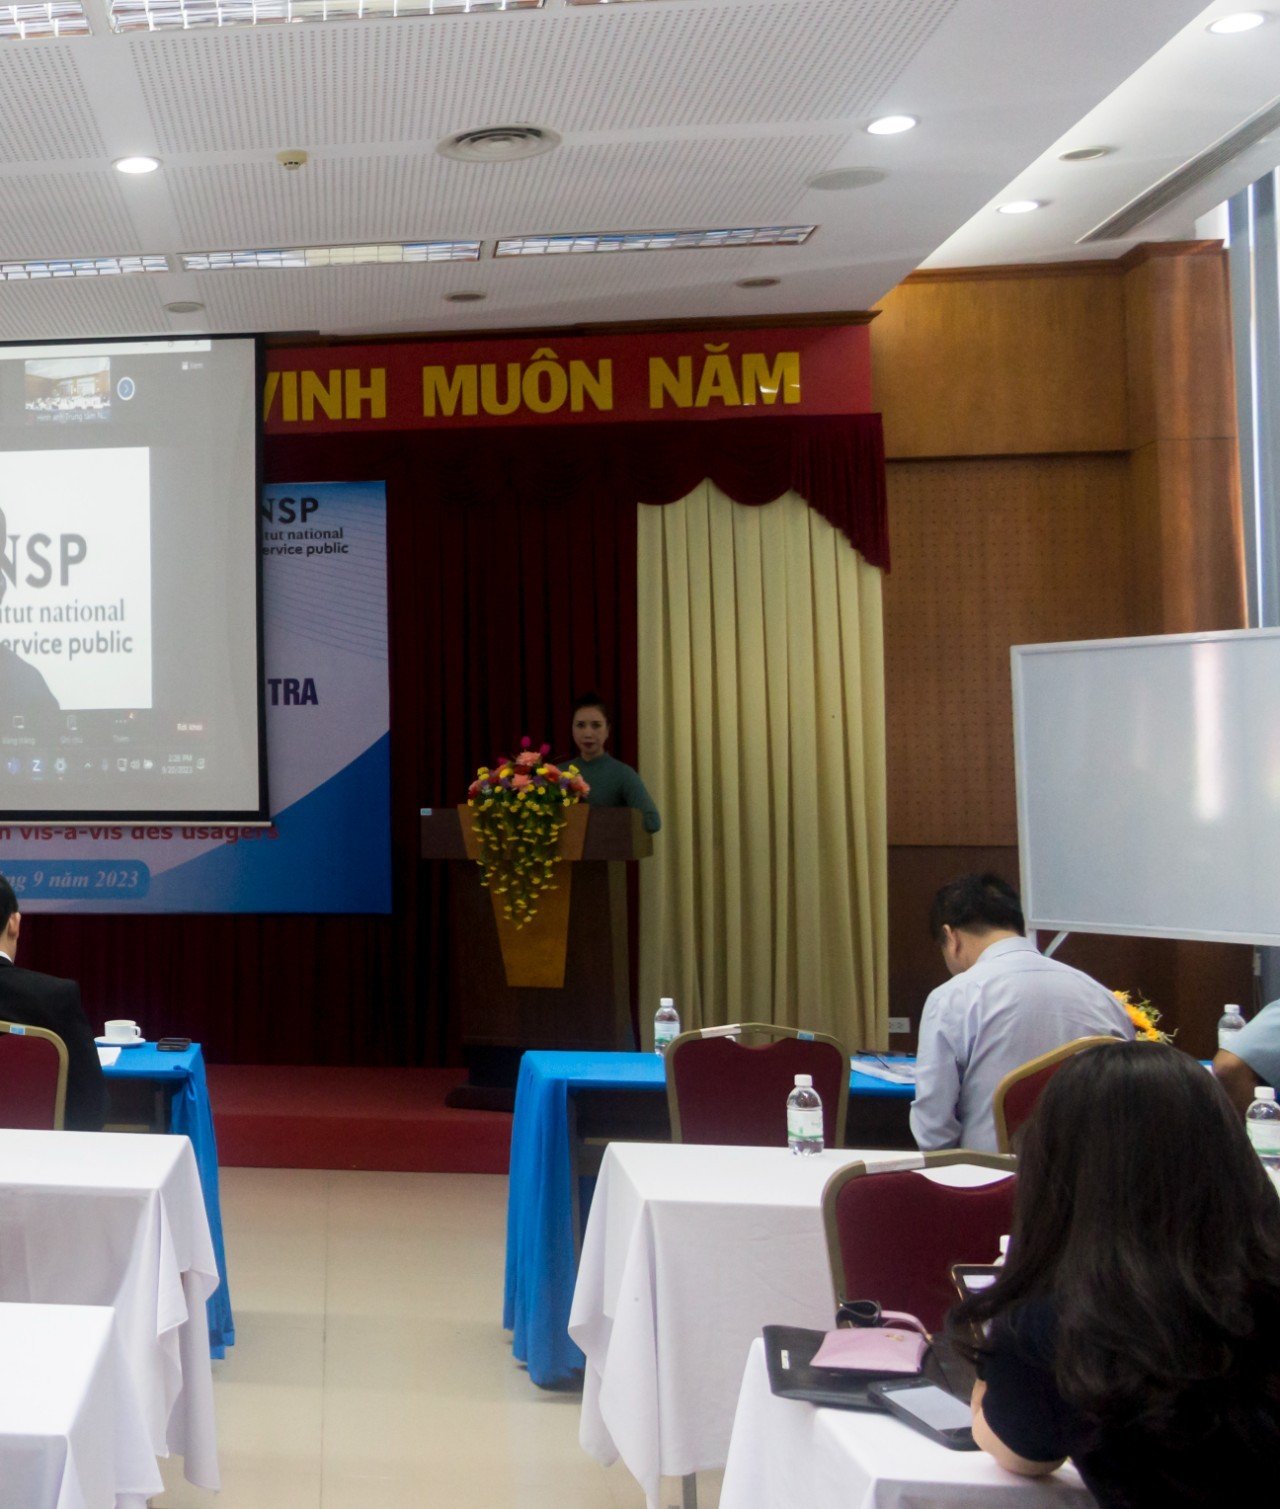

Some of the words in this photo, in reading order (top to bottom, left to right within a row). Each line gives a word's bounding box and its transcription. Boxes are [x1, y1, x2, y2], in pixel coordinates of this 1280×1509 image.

[422, 347, 614, 418] MUÔN
[649, 342, 802, 409] NĂM
[287, 527, 343, 540] national
[306, 542, 349, 557] public
[39, 597, 125, 623] national
[68, 630, 133, 661] public
[267, 677, 319, 706] TRA
[131, 826, 173, 840] des
[33, 870, 45, 887] 9
[48, 871, 90, 888] năm
[94, 869, 139, 888] 2023
